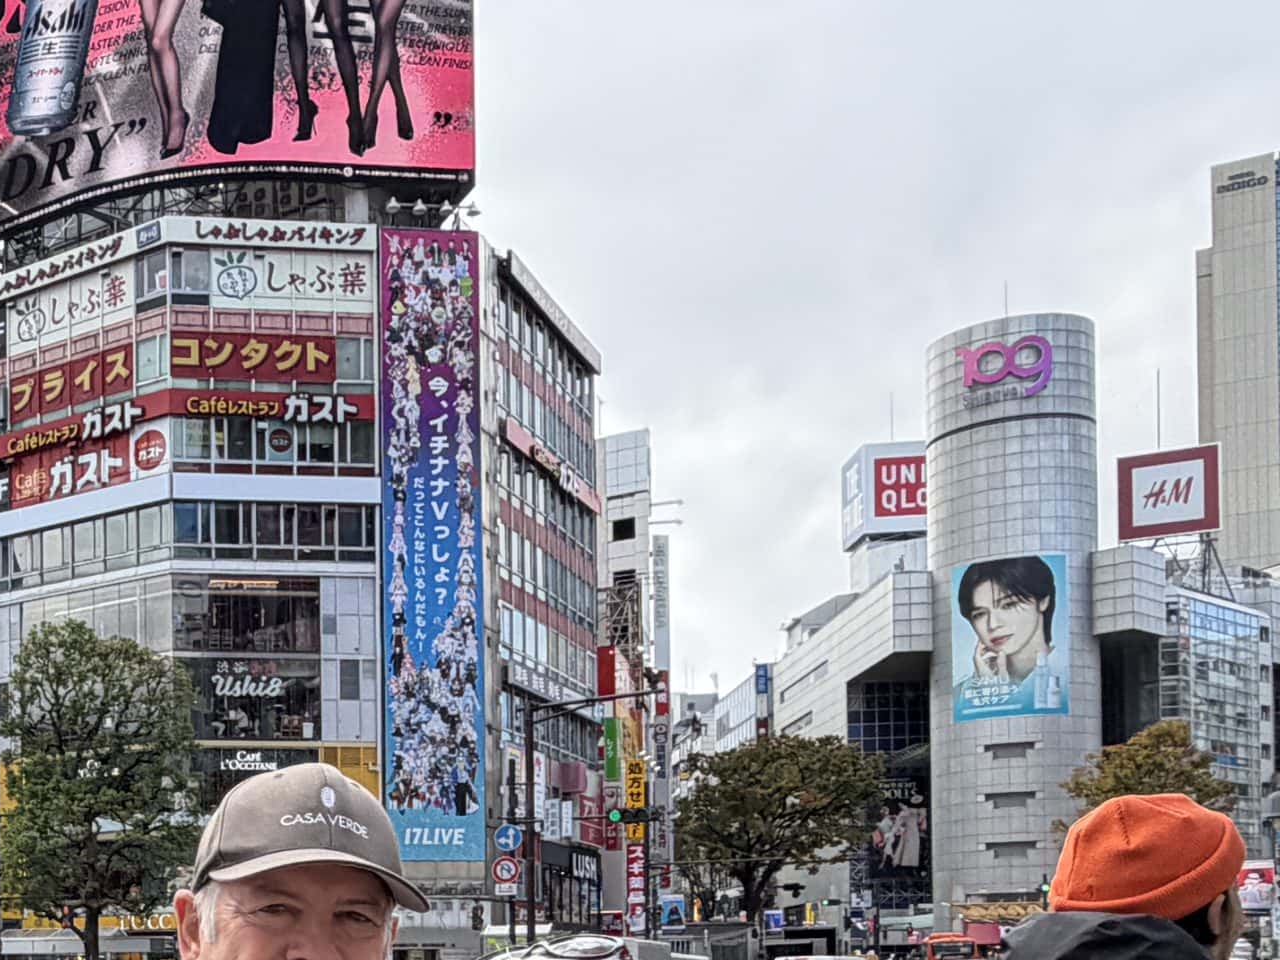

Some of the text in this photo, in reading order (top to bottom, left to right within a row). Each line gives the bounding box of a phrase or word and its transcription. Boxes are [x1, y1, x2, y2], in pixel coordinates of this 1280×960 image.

[116, 14, 136, 28] THE
[41, 41, 58, 55] 生
[196, 220, 367, 246] しゃぶしゃぶバイキング
[268, 262, 367, 295] しゃぶ葉
[52, 275, 126, 325] しゃぶ葉
[172, 338, 329, 372] コンタクト
[955, 335, 1052, 398] 109
[12, 351, 131, 413] プライス
[82, 400, 143, 440] ガスト
[284, 393, 358, 423] ガスト
[49, 449, 123, 498] ガスト
[881, 463, 927, 485] UNI
[1143, 476, 1193, 510] H&M
[280, 812, 369, 839] CASA VERDE
[404, 828, 465, 845] 17LIVE
[572, 852, 597, 881] LUSH
